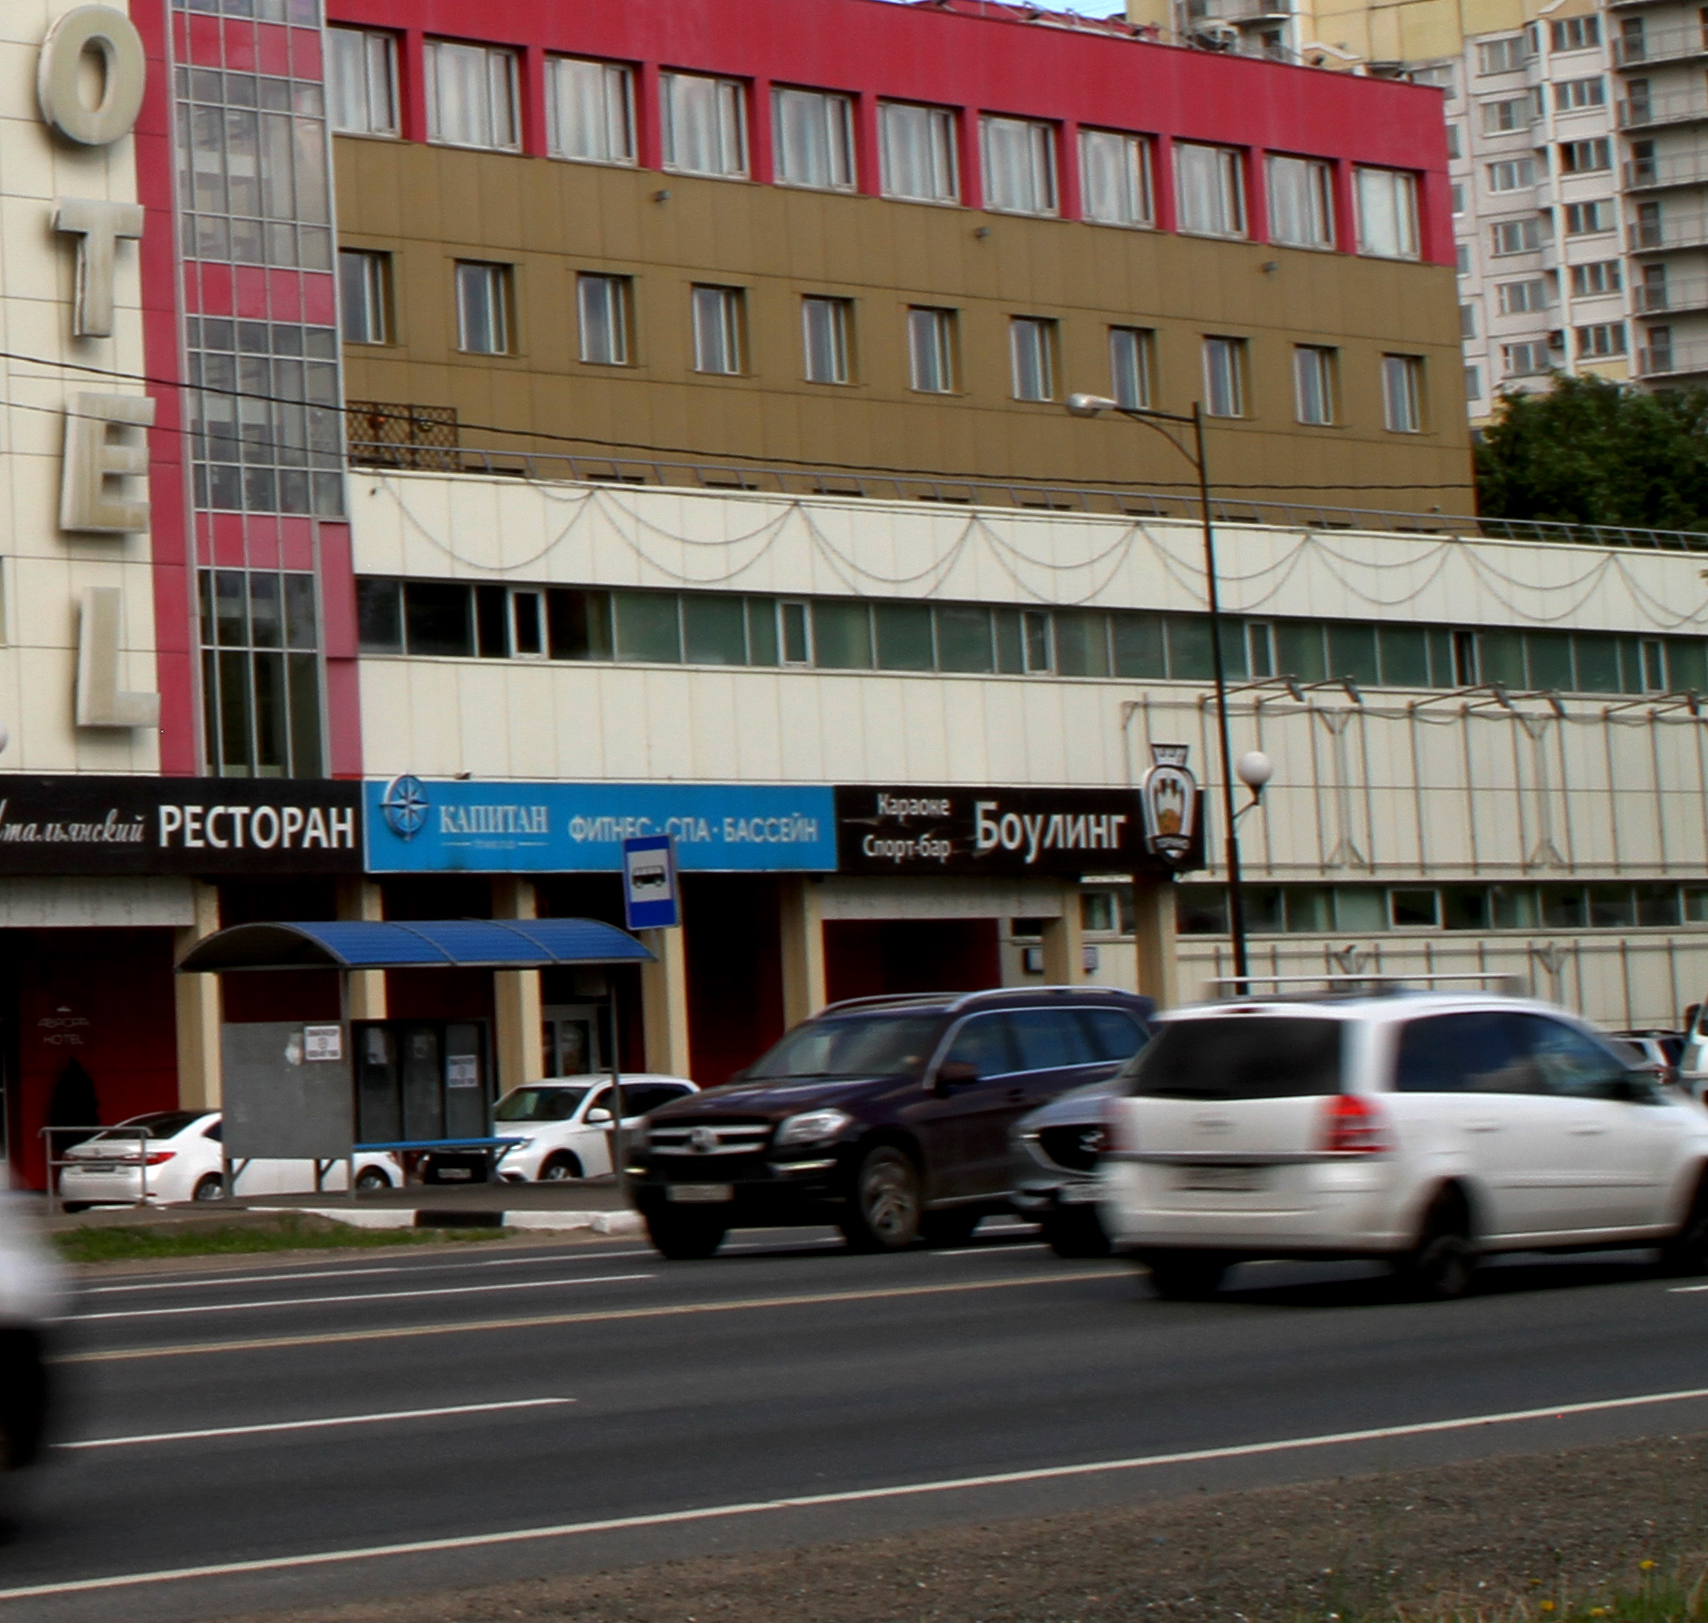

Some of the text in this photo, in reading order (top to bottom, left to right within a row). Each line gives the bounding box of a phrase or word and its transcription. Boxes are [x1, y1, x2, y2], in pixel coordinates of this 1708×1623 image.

[439, 804, 549, 834] КАПИТАН
[877, 793, 951, 822] Караоке
[158, 804, 355, 850] РЕСТОРАН
[568, 812, 819, 843] ФИТНЕС СПА БАССЕЙН
[975, 800, 1127, 864] Боулинг
[863, 833, 952, 864] Спорт-бар
